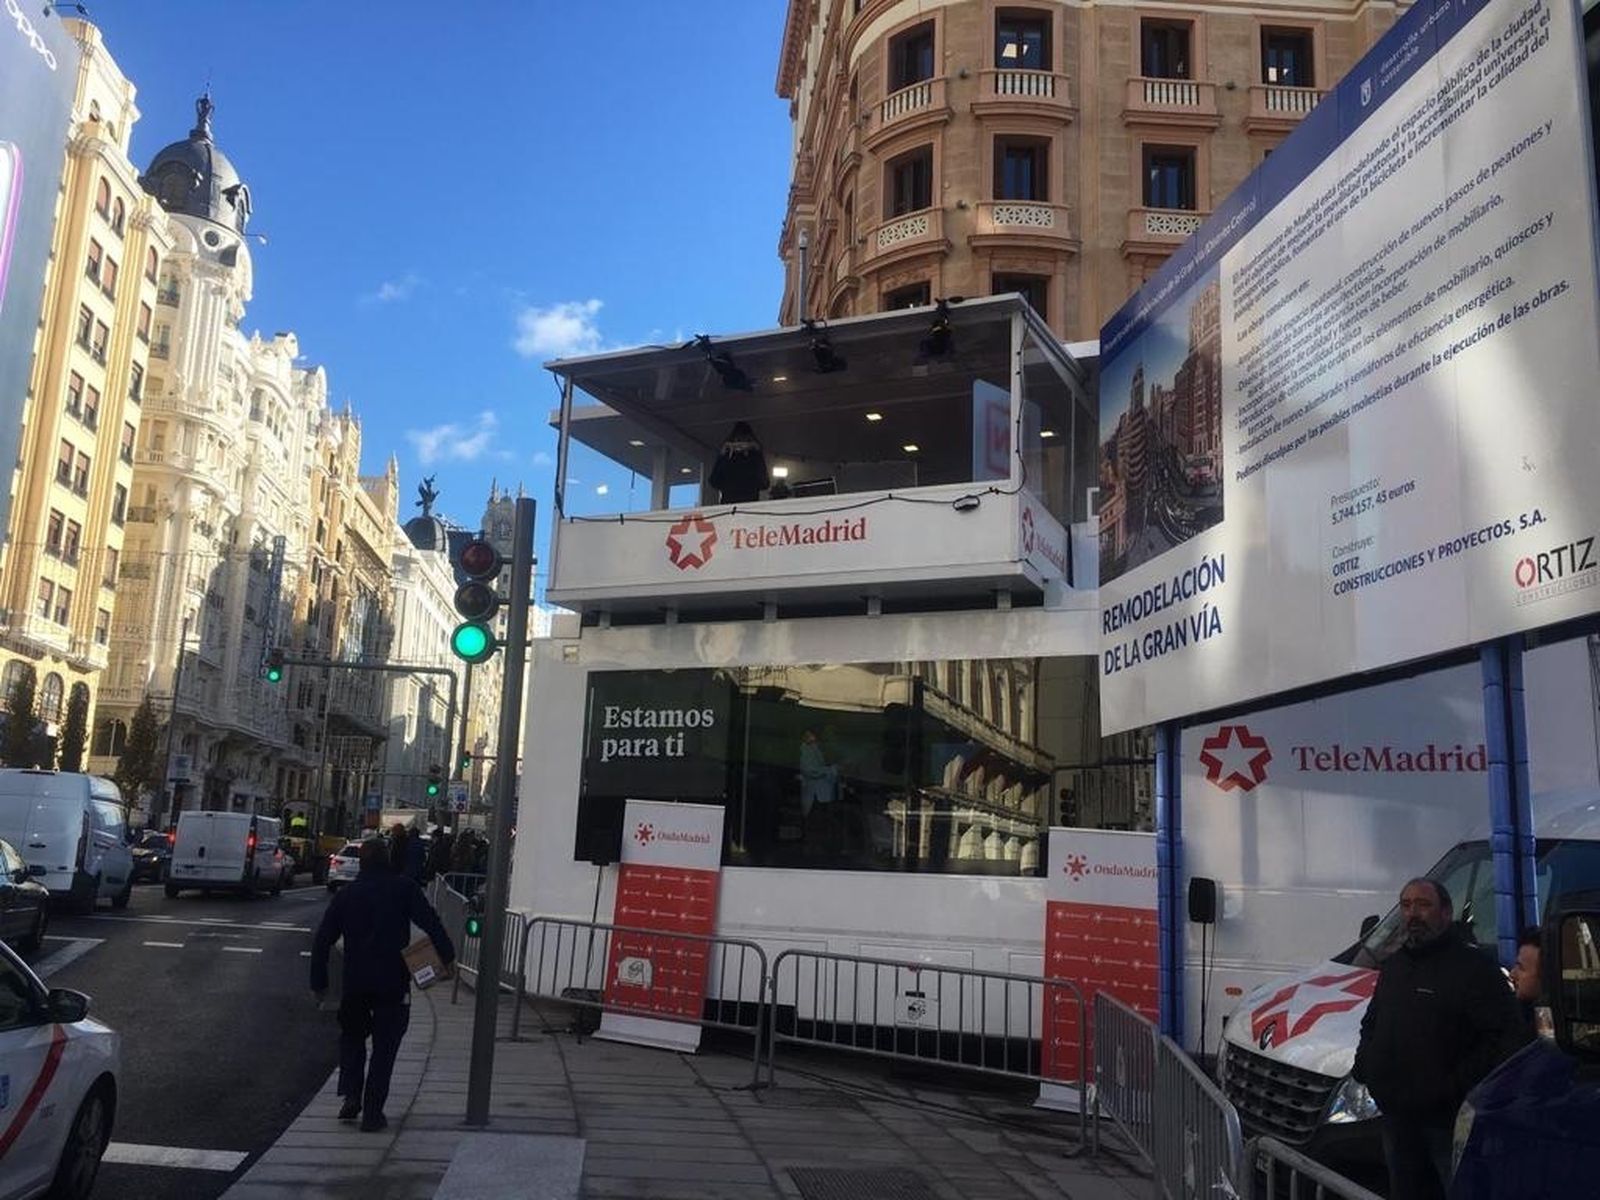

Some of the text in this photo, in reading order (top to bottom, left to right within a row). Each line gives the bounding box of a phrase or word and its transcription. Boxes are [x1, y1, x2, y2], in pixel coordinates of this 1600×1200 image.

[1293, 196, 1320, 229] Madrid
[1337, 136, 1391, 190] remodelando
[1401, 95, 1436, 134] espacio
[1436, 60, 1475, 106] público
[1476, 47, 1490, 67] de
[1491, 37, 1501, 54] la
[1503, 0, 1542, 43] ciudad
[1323, 173, 1362, 217] movilidad
[1362, 140, 1400, 186] peatonal
[1417, 68, 1482, 135] accesibilidad
[1483, 20, 1540, 79] universal,
[1538, 7, 1551, 31] el
[1369, 153, 1406, 192] bicicleta
[1414, 94, 1475, 154] incrementar
[1476, 83, 1487, 102] la
[1488, 44, 1530, 91] calidad
[1529, 27, 1550, 56] del
[1344, 237, 1397, 286] construcción
[1398, 227, 1410, 245] de
[1410, 201, 1444, 236] nuevos
[1444, 178, 1475, 214] pasos
[1475, 166, 1490, 187] de
[1491, 126, 1543, 179] peatones
[1354, 288, 1371, 308] con
[1371, 243, 1434, 296] incorporación
[1433, 233, 1447, 251] de
[1447, 194, 1505, 241] mobiliario,
[1327, 347, 1351, 370] orden
[1363, 330, 1376, 347] los
[1376, 299, 1423, 338] elementos
[1423, 290, 1437, 307] de
[1436, 254, 1493, 298] mobiliario,
[1494, 217, 1545, 264] quioscos
[1381, 278, 1410, 304] beber.
[1350, 349, 1394, 384] semáforos
[1394, 341, 1407, 357] de
[1407, 311, 1455, 349] eficiencia
[1454, 274, 1516, 319] energética.
[1293, 432, 1307, 451] por
[1307, 426, 1319, 440] las
[1319, 407, 1351, 436] posibles
[1351, 382, 1393, 414] molestias
[1393, 359, 1431, 390] durante
[1432, 352, 1443, 367] la
[1442, 321, 1496, 361] ejecución
[1496, 311, 1512, 330] de
[1512, 301, 1530, 321] las
[1531, 279, 1570, 310] obras.
[1330, 476, 1380, 509] Presupuesto:
[1331, 478, 1415, 526] 5.744.157, 45 euros
[730, 517, 866, 548] TeleMadrid
[1331, 533, 1374, 560] Construye:
[1333, 507, 1547, 597] CONSTRUCCIONES Y PROYECTOS, S.A.
[1516, 537, 1597, 588] ORTIZ
[1103, 554, 1225, 635] REMODELACIÓN
[1332, 554, 1359, 577] ORTIZ
[1104, 602, 1222, 675] DE LA GRAN VÍA
[601, 732, 684, 762] para ti
[603, 706, 714, 728] Estamos
[1291, 744, 1487, 772] TeleMadrid
[657, 832, 710, 844] OndaMadrid
